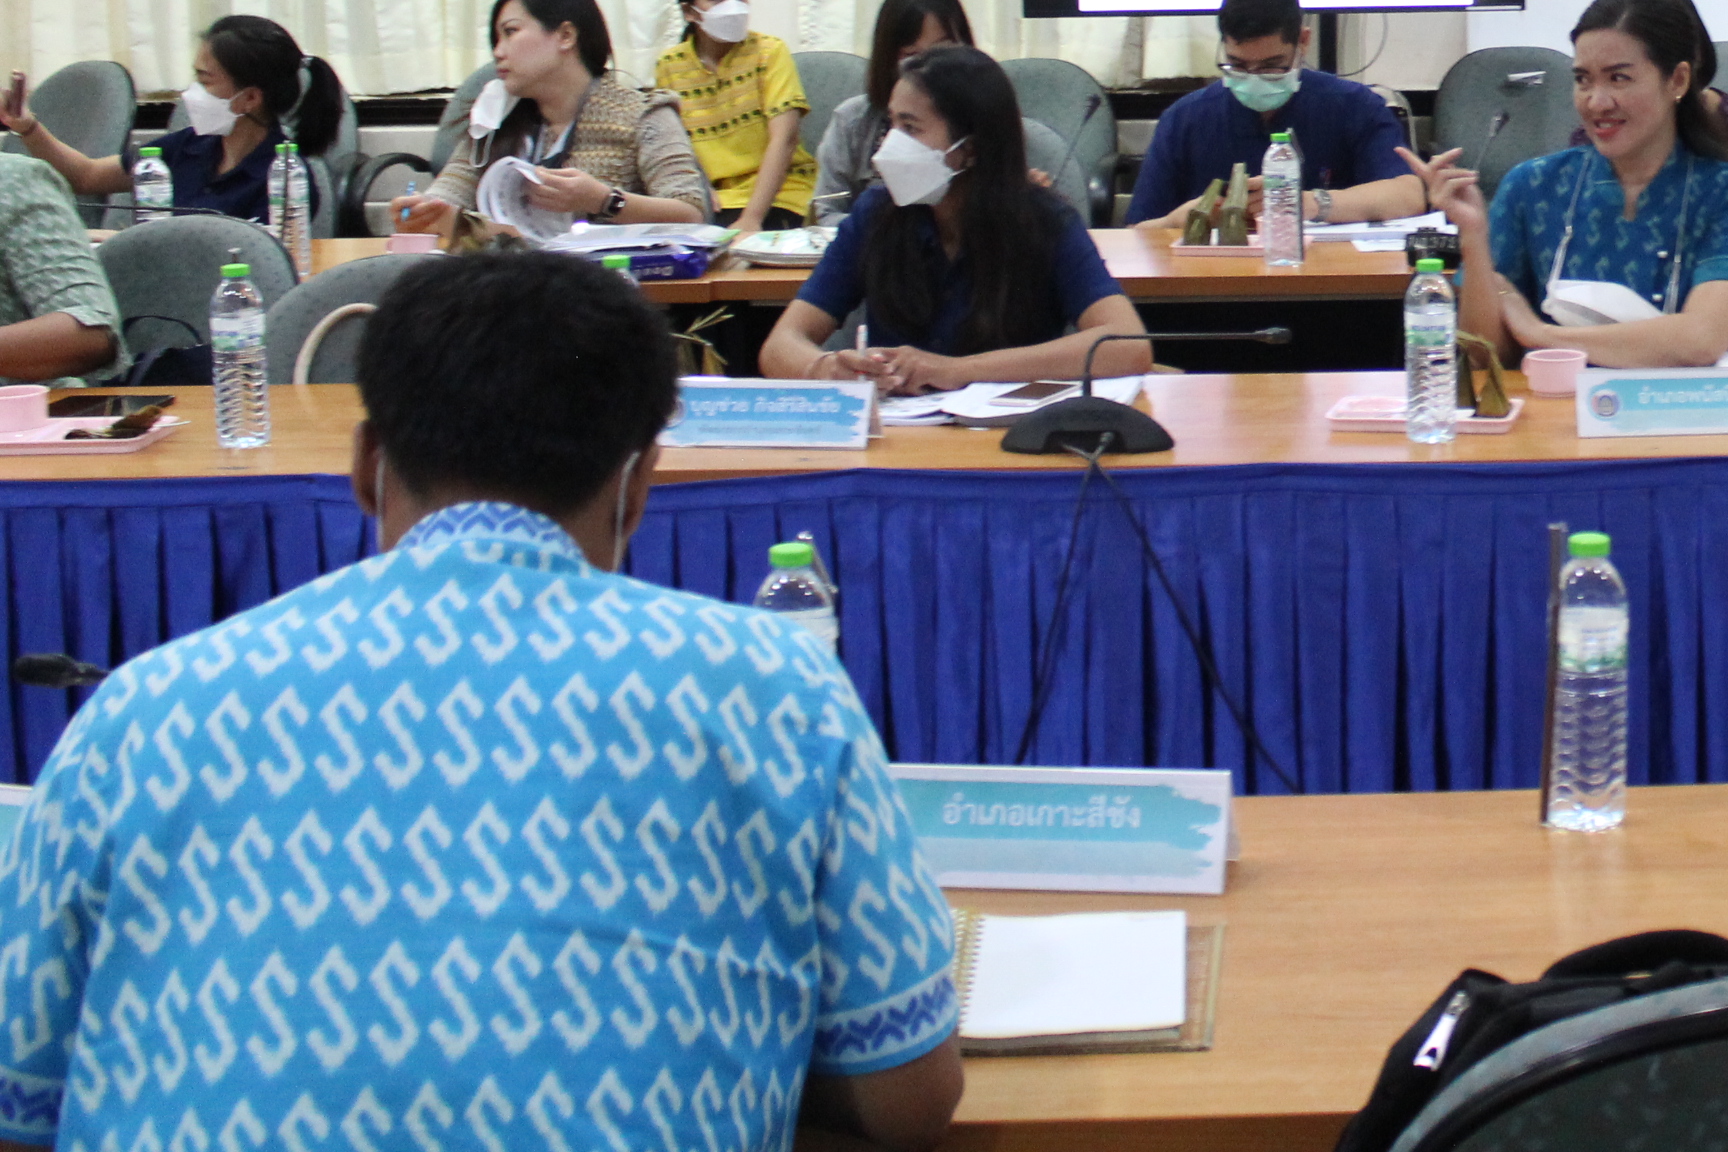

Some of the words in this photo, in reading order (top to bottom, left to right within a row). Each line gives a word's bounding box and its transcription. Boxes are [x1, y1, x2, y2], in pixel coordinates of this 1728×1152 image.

[942, 792, 1141, 829] อำเภอเกาะสีชัง
